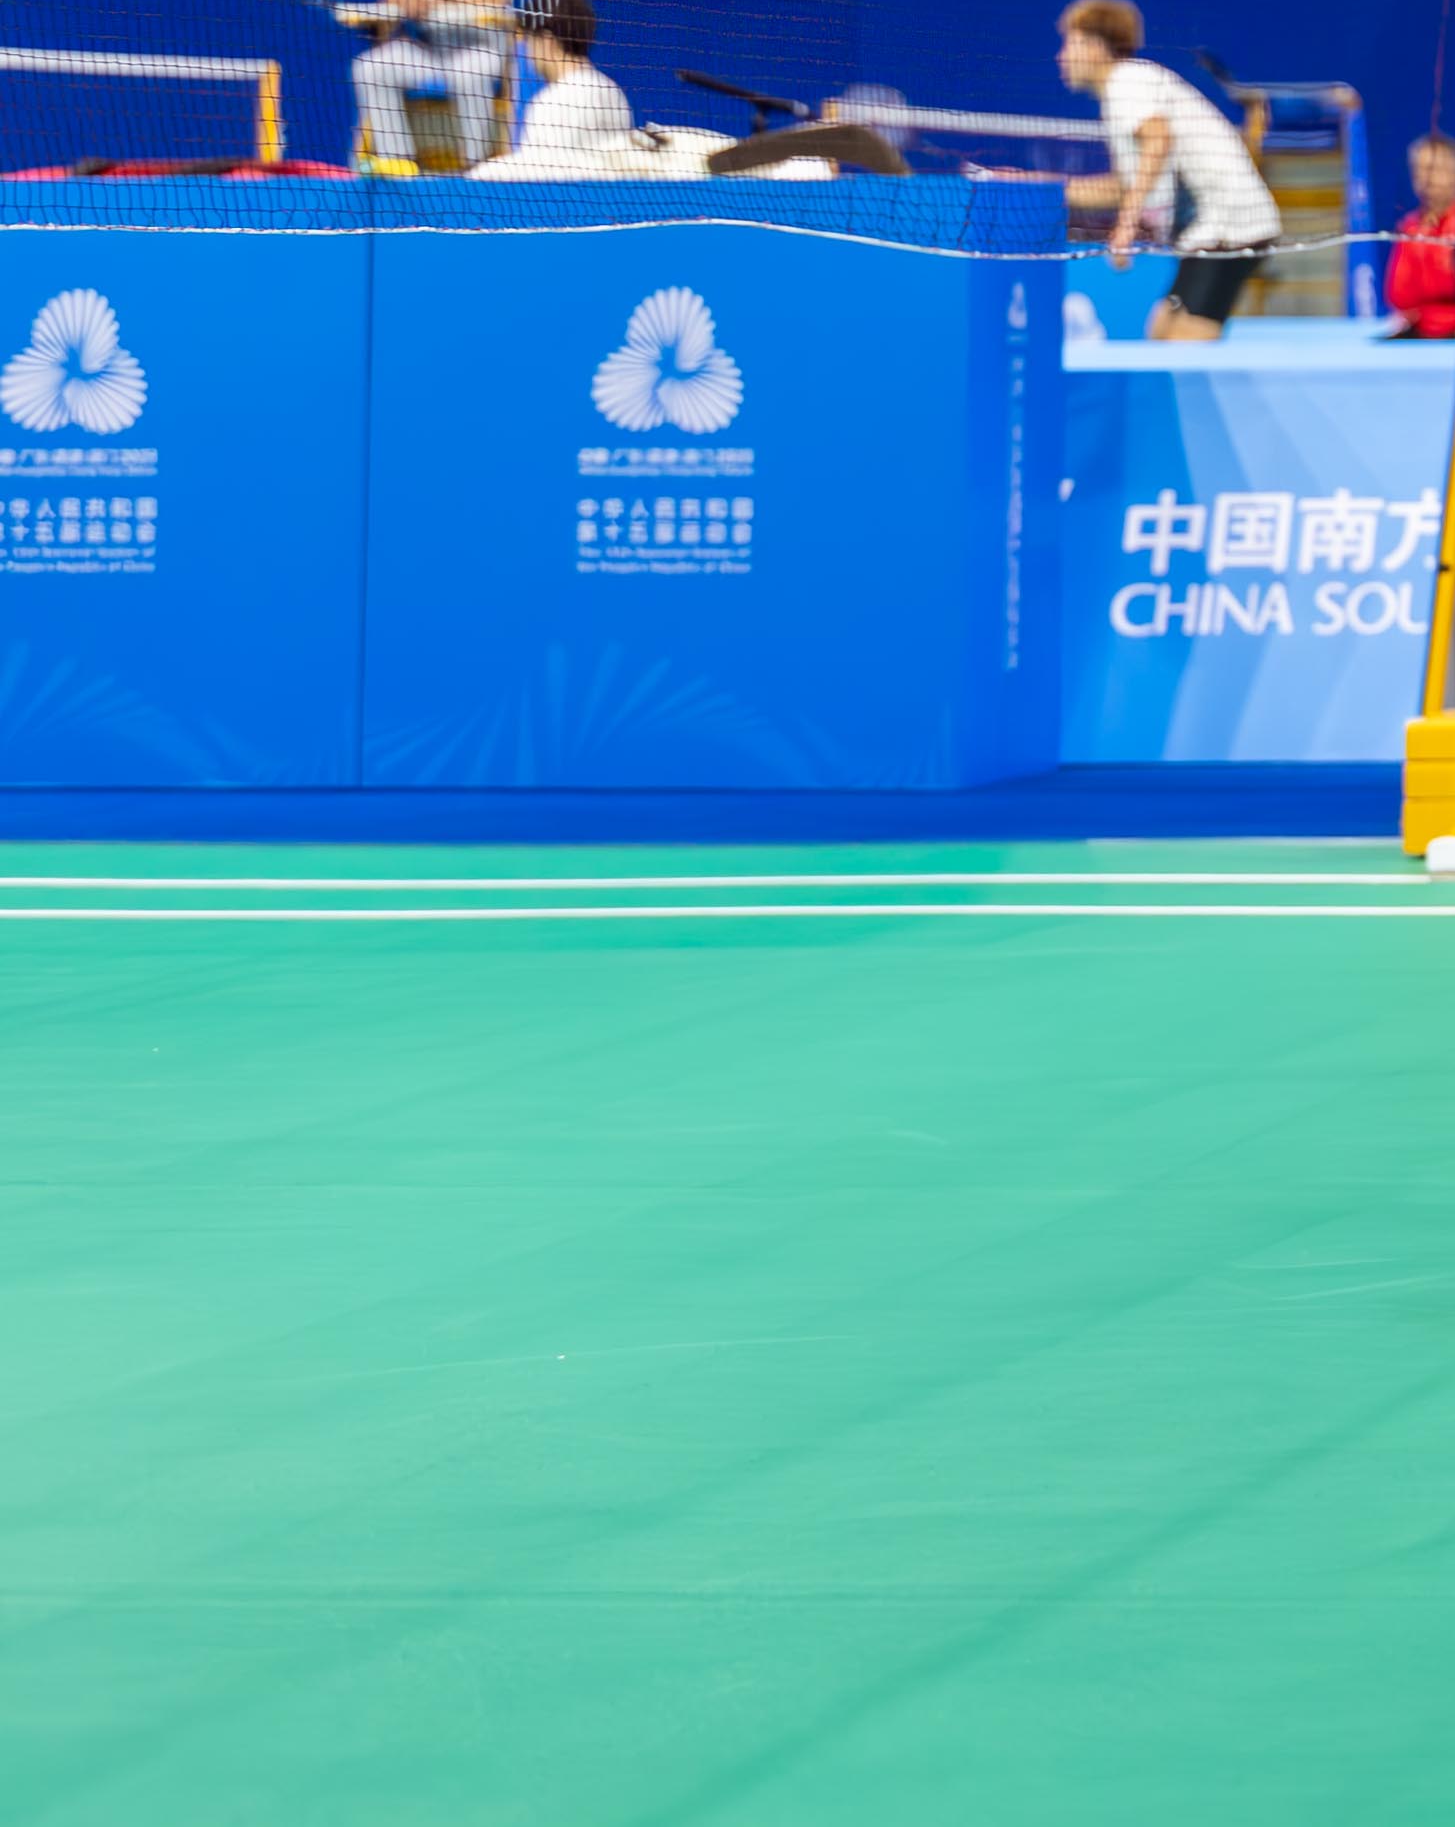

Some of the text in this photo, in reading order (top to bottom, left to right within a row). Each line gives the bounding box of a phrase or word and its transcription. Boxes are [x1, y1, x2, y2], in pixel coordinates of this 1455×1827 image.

[1122, 488, 1439, 577] 中国南方
[1110, 581, 1296, 638] CHINA
